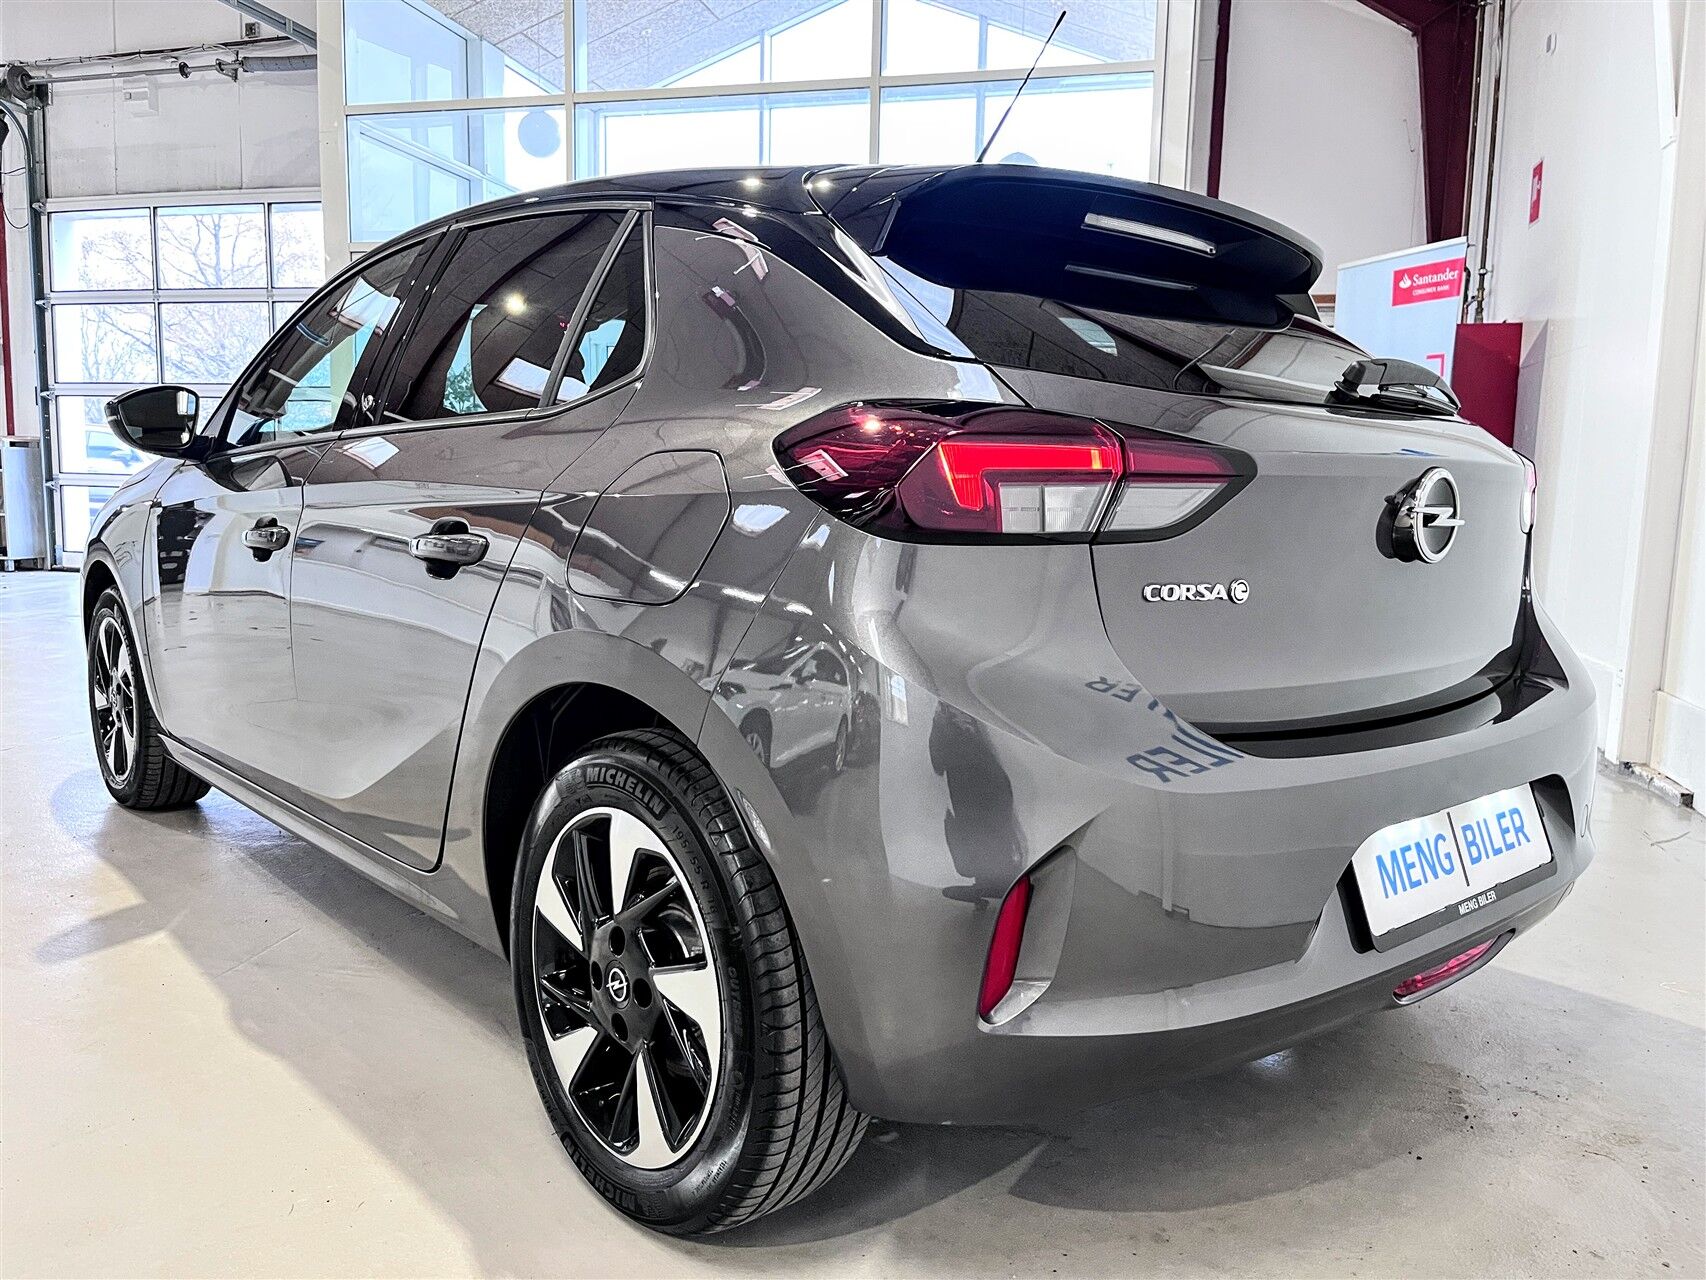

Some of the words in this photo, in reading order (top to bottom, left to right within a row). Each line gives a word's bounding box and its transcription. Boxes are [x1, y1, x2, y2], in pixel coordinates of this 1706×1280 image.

[1413, 267, 1459, 286] Santander
[1142, 583, 1229, 602] CORSA
[585, 767, 665, 815] MICHELIN
[1375, 832, 1455, 899] MENG
[1460, 807, 1531, 866] BILER
[1458, 898, 1479, 916] MENG
[1477, 890, 1497, 907] BILER
